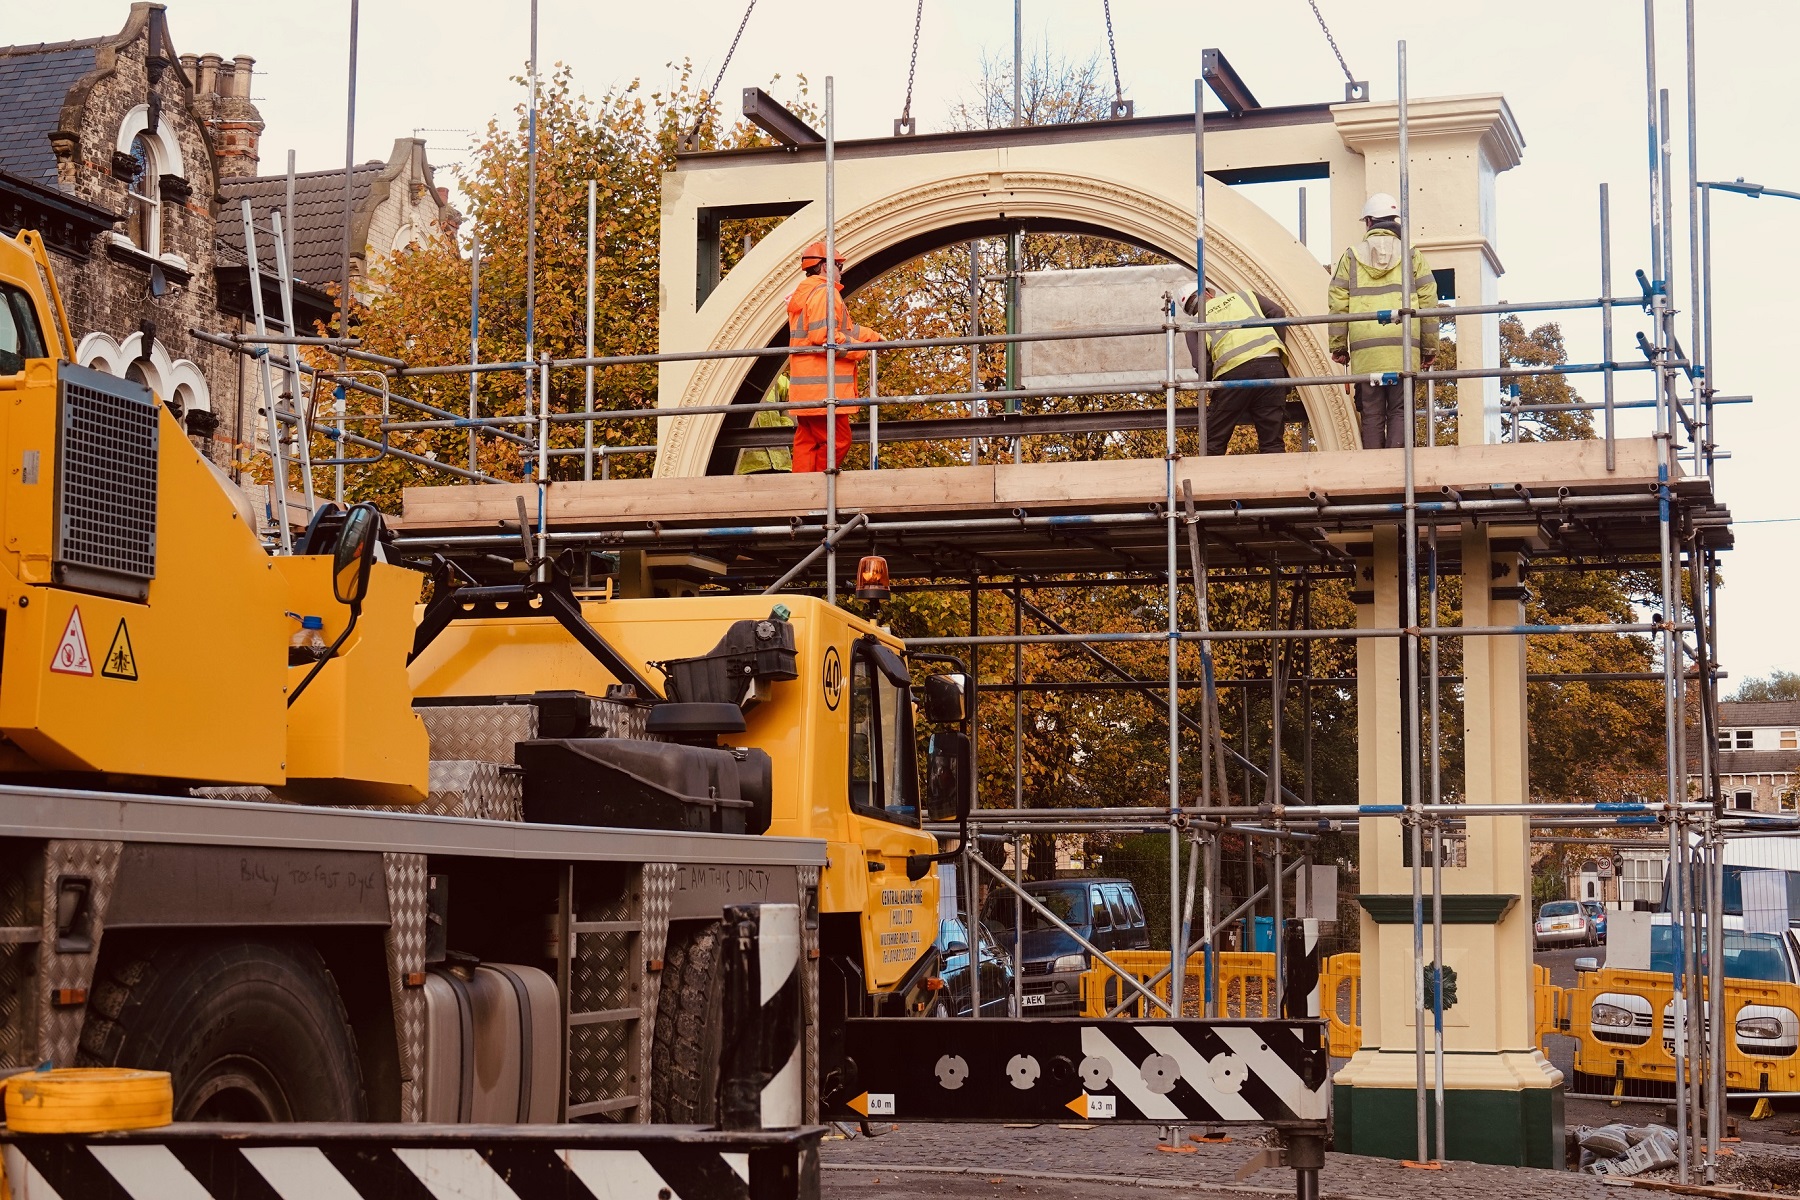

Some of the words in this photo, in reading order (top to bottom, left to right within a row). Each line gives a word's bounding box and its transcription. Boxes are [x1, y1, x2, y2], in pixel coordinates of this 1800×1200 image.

[1223, 296, 1236, 305] ART
[826, 659, 839, 697] 40
[677, 867, 687, 891] I
[691, 867, 706, 890] AM
[708, 867, 731, 893] THIS
[738, 868, 771, 902] DIRTY
[882, 891, 899, 905] CENTRAL
[900, 890, 912, 904] CRANE
[914, 890, 922, 904] HIRE
[881, 933, 898, 945] WILTSHIRE
[1026, 995, 1042, 1005] AEK
[870, 1099, 882, 1109] 6.0
[884, 1101, 892, 1109] m
[1090, 1100, 1103, 1111] 4.3
[1105, 1103, 1113, 1111] m
